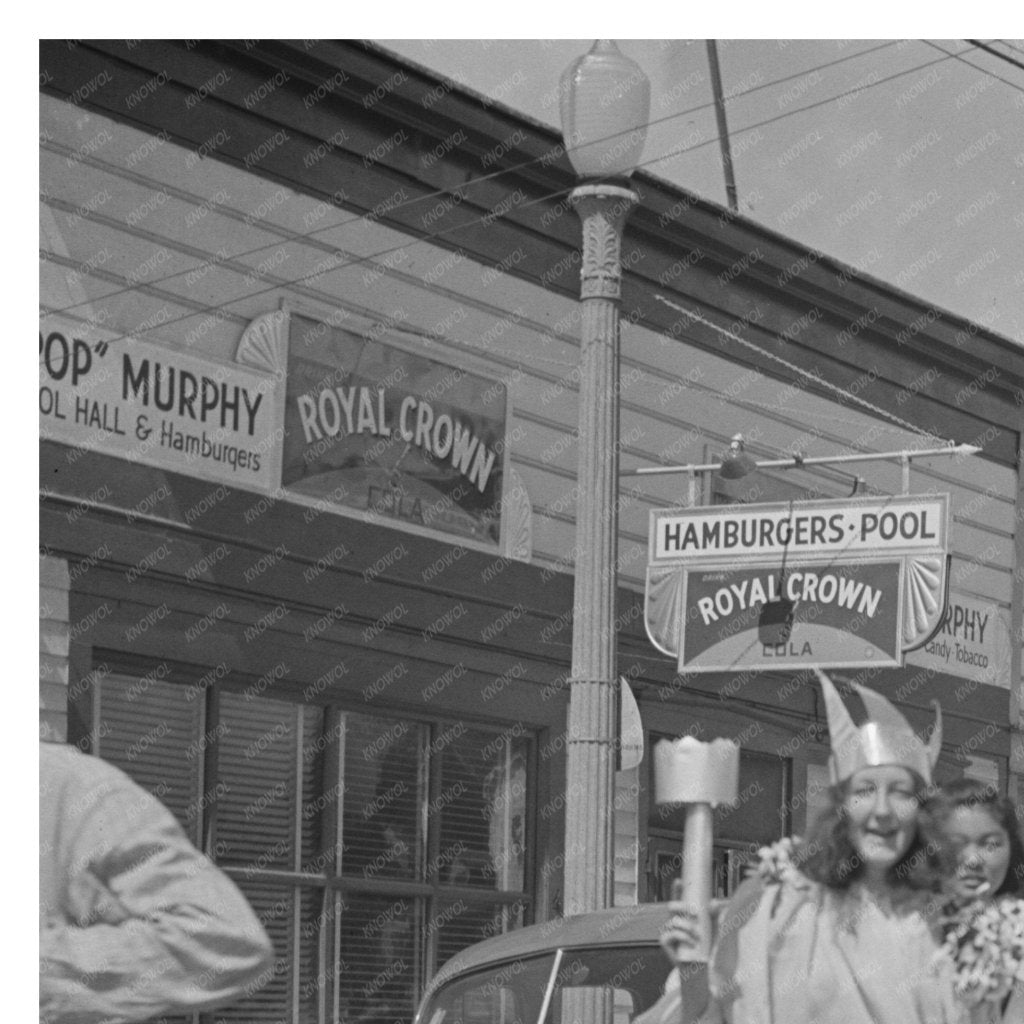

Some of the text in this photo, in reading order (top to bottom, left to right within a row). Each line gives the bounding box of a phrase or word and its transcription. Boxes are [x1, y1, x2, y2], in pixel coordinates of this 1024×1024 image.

[123, 353, 263, 435] MURPHY
[75, 396, 126, 435] HALL
[136, 414, 152, 440] &
[160, 420, 261, 471] Hamburgers
[297, 386, 496, 493] ROYAL CROWN
[861, 510, 936, 541] POOL
[697, 572, 882, 625] ROYAL CROWN
[762, 641, 813, 657] COLA
